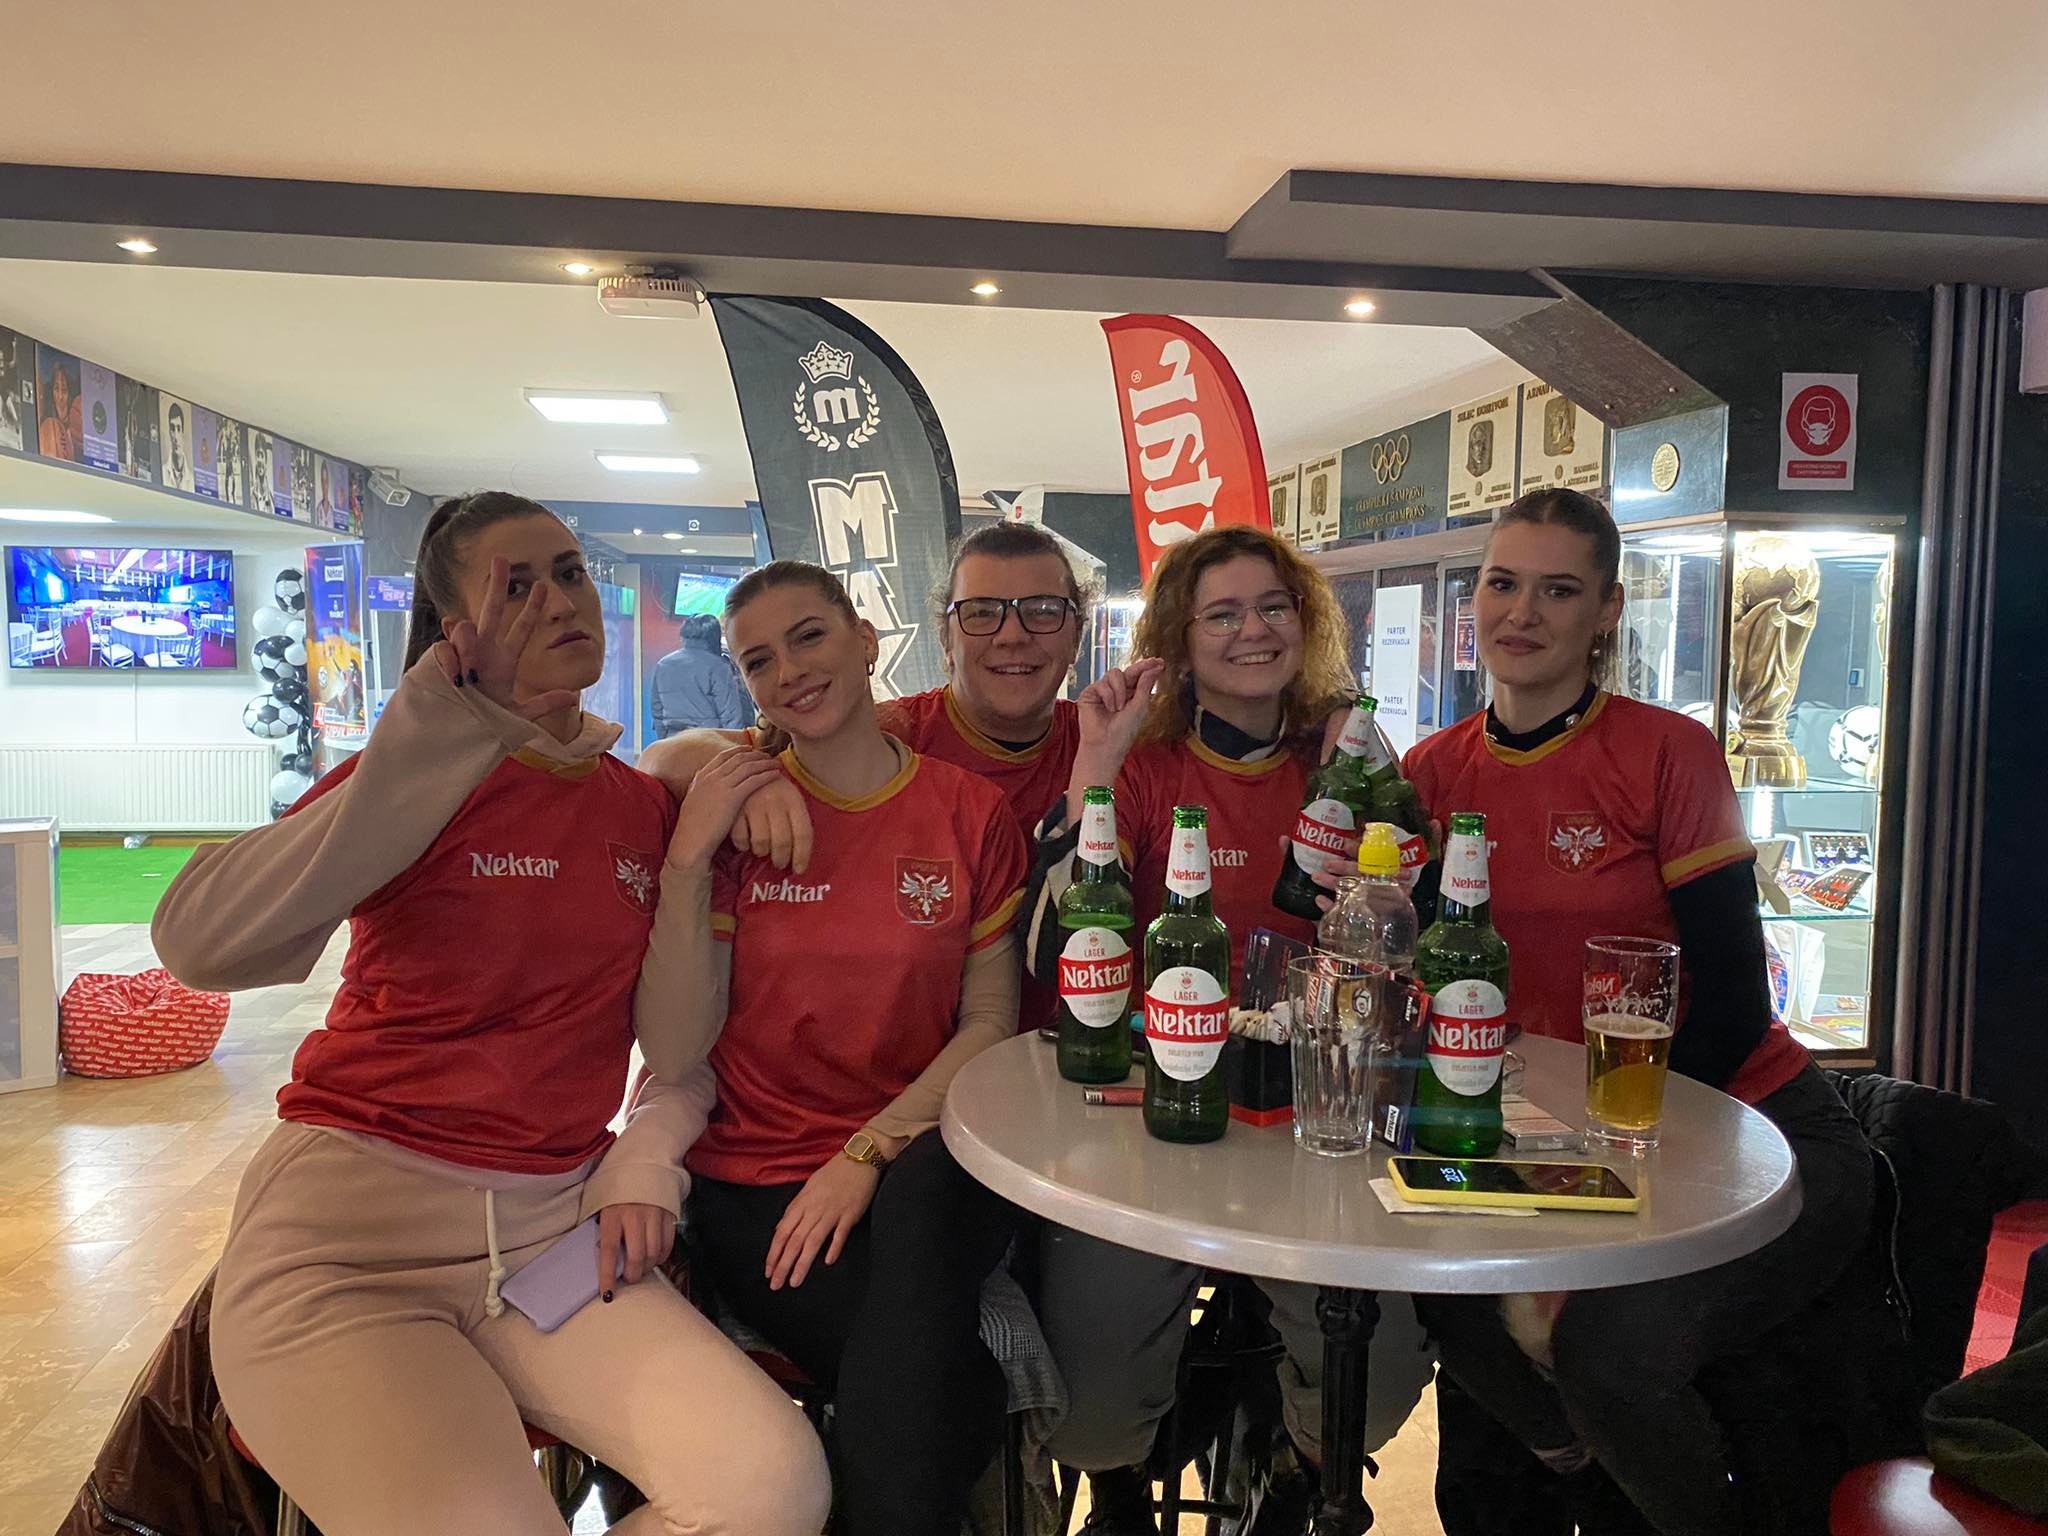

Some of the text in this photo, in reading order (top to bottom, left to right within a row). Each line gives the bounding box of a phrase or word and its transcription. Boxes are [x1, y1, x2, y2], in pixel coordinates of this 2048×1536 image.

[1386, 626, 1406, 635] PARTER
[1384, 696, 1403, 705] PARTER
[1295, 819, 1345, 850] Nekta
[1085, 841, 1115, 851] Nektar
[1208, 847, 1249, 867] ktar
[469, 852, 560, 879] Nektar
[1172, 869, 1206, 881] Nektar
[1452, 876, 1488, 889] Nektar
[750, 877, 831, 904] Nektar
[1083, 947, 1106, 958] LAGER
[1062, 961, 1131, 989] Nektar
[1173, 990, 1199, 1001] LAGER
[1458, 1004, 1485, 1015] LAGER
[1148, 1003, 1226, 1037] Nektar
[1427, 1020, 1506, 1051] Nektar
